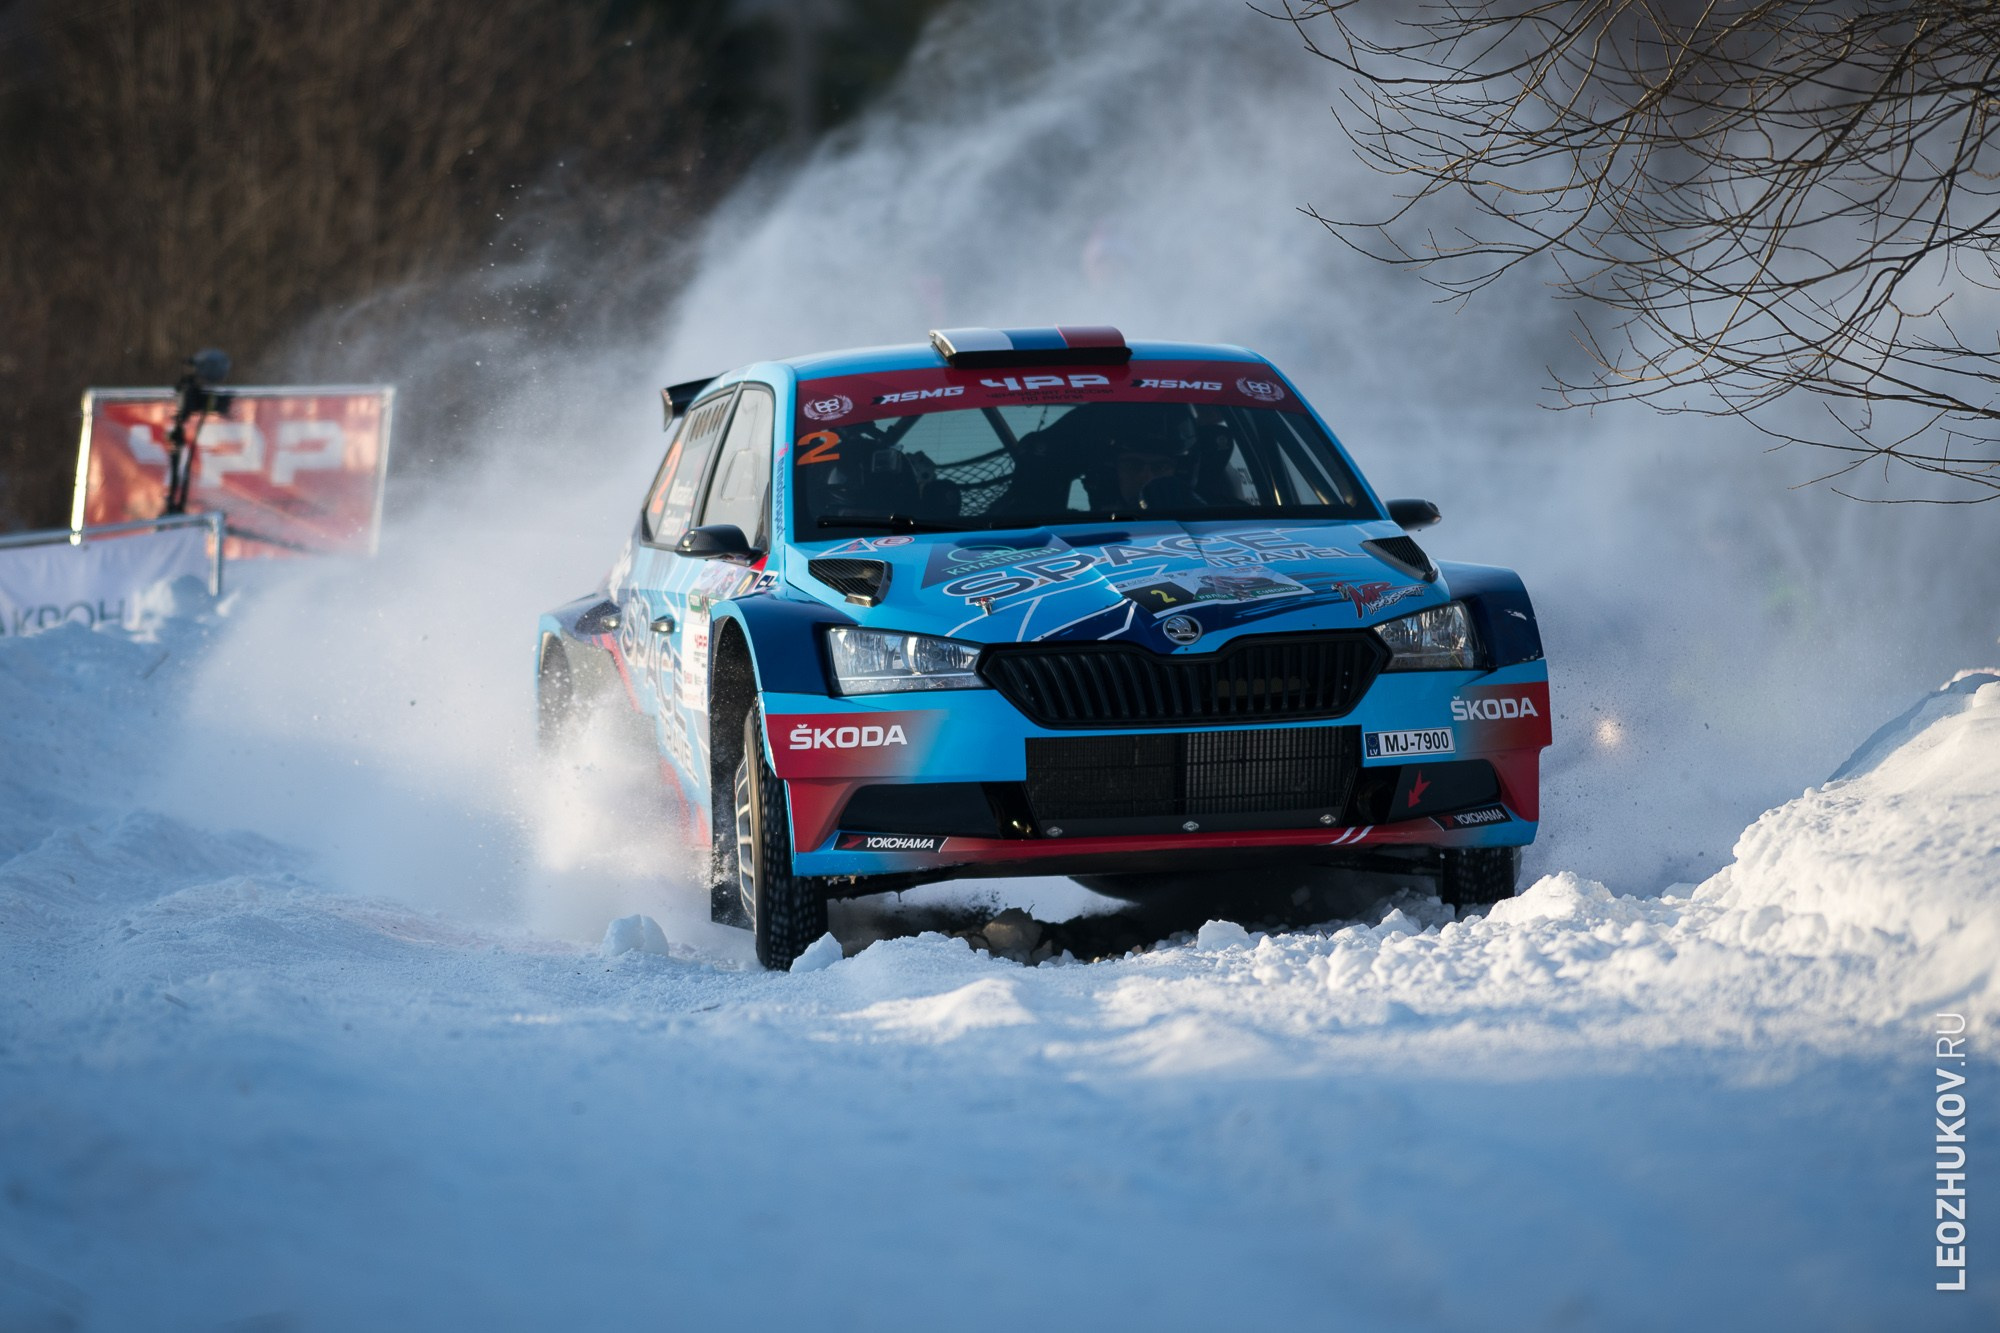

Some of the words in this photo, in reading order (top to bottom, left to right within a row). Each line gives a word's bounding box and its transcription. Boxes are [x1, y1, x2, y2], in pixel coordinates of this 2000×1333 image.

[880, 386, 965, 405] ASMG
[1140, 379, 1223, 391] ASMG
[796, 431, 841, 466] 2
[943, 530, 1313, 606] SPACE
[1205, 547, 1373, 568] TRAVEL
[1150, 589, 1178, 604] 2
[0, 598, 126, 637] КРОН
[1450, 695, 1539, 721] ŠKODA
[789, 723, 908, 750] ŠKODA
[1384, 731, 1450, 753] MJ-7900
[1453, 808, 1506, 825] YOKOHAMA
[866, 836, 935, 849] YOKOHAMA
